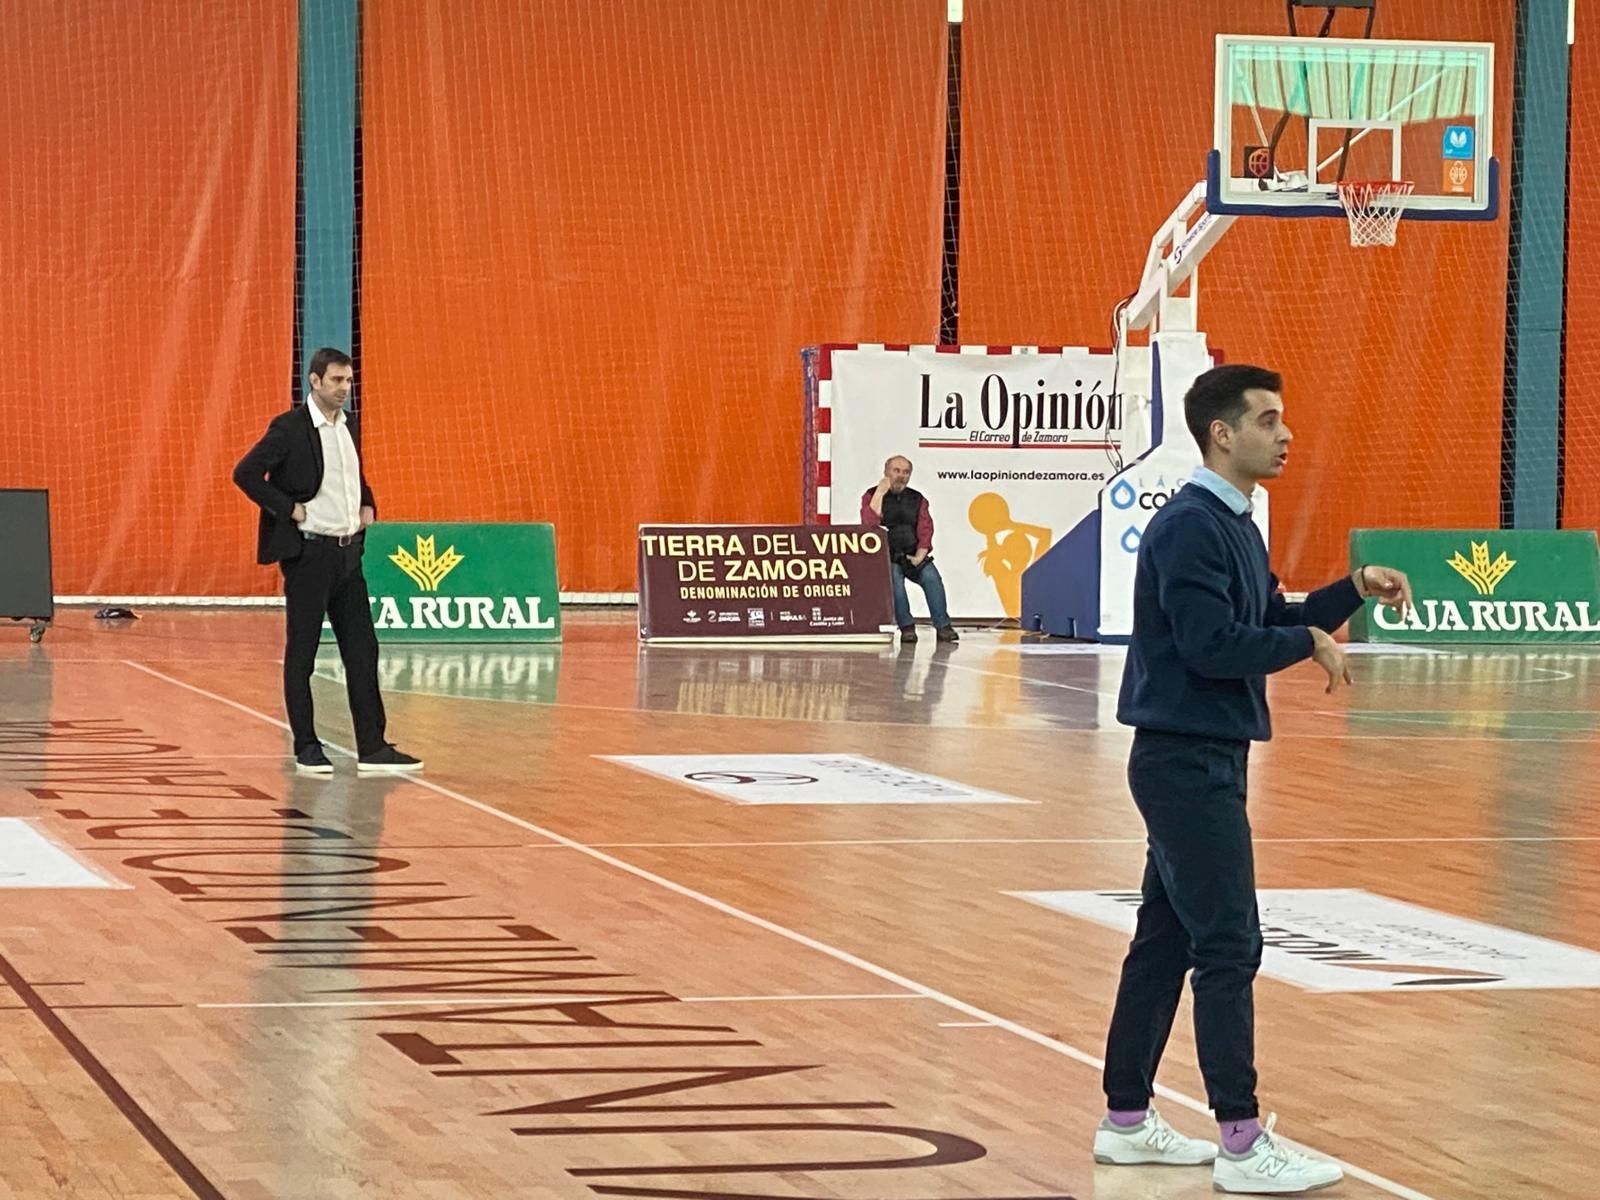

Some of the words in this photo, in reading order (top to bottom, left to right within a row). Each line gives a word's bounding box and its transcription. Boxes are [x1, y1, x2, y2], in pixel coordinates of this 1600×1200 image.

[919, 373, 967, 429] La
[980, 373, 1124, 449] Opinión
[969, 431, 978, 442] El
[979, 431, 1010, 442] Correo
[1021, 431, 1032, 442] de
[1033, 431, 1068, 443] Zamora
[937, 469, 1105, 482] www.laopiniondezamora.es
[641, 534, 745, 556] TIERRA
[753, 534, 806, 556] DEL
[811, 532, 881, 555] VINO
[678, 560, 716, 582] DE
[725, 558, 848, 581] ZAMORA
[680, 583, 778, 600] DENOMINACIÓN
[783, 585, 799, 598] DE
[804, 584, 851, 598] ORIGEN
[409, 596, 555, 630] RURAL
[1469, 600, 1600, 632] RURAL
